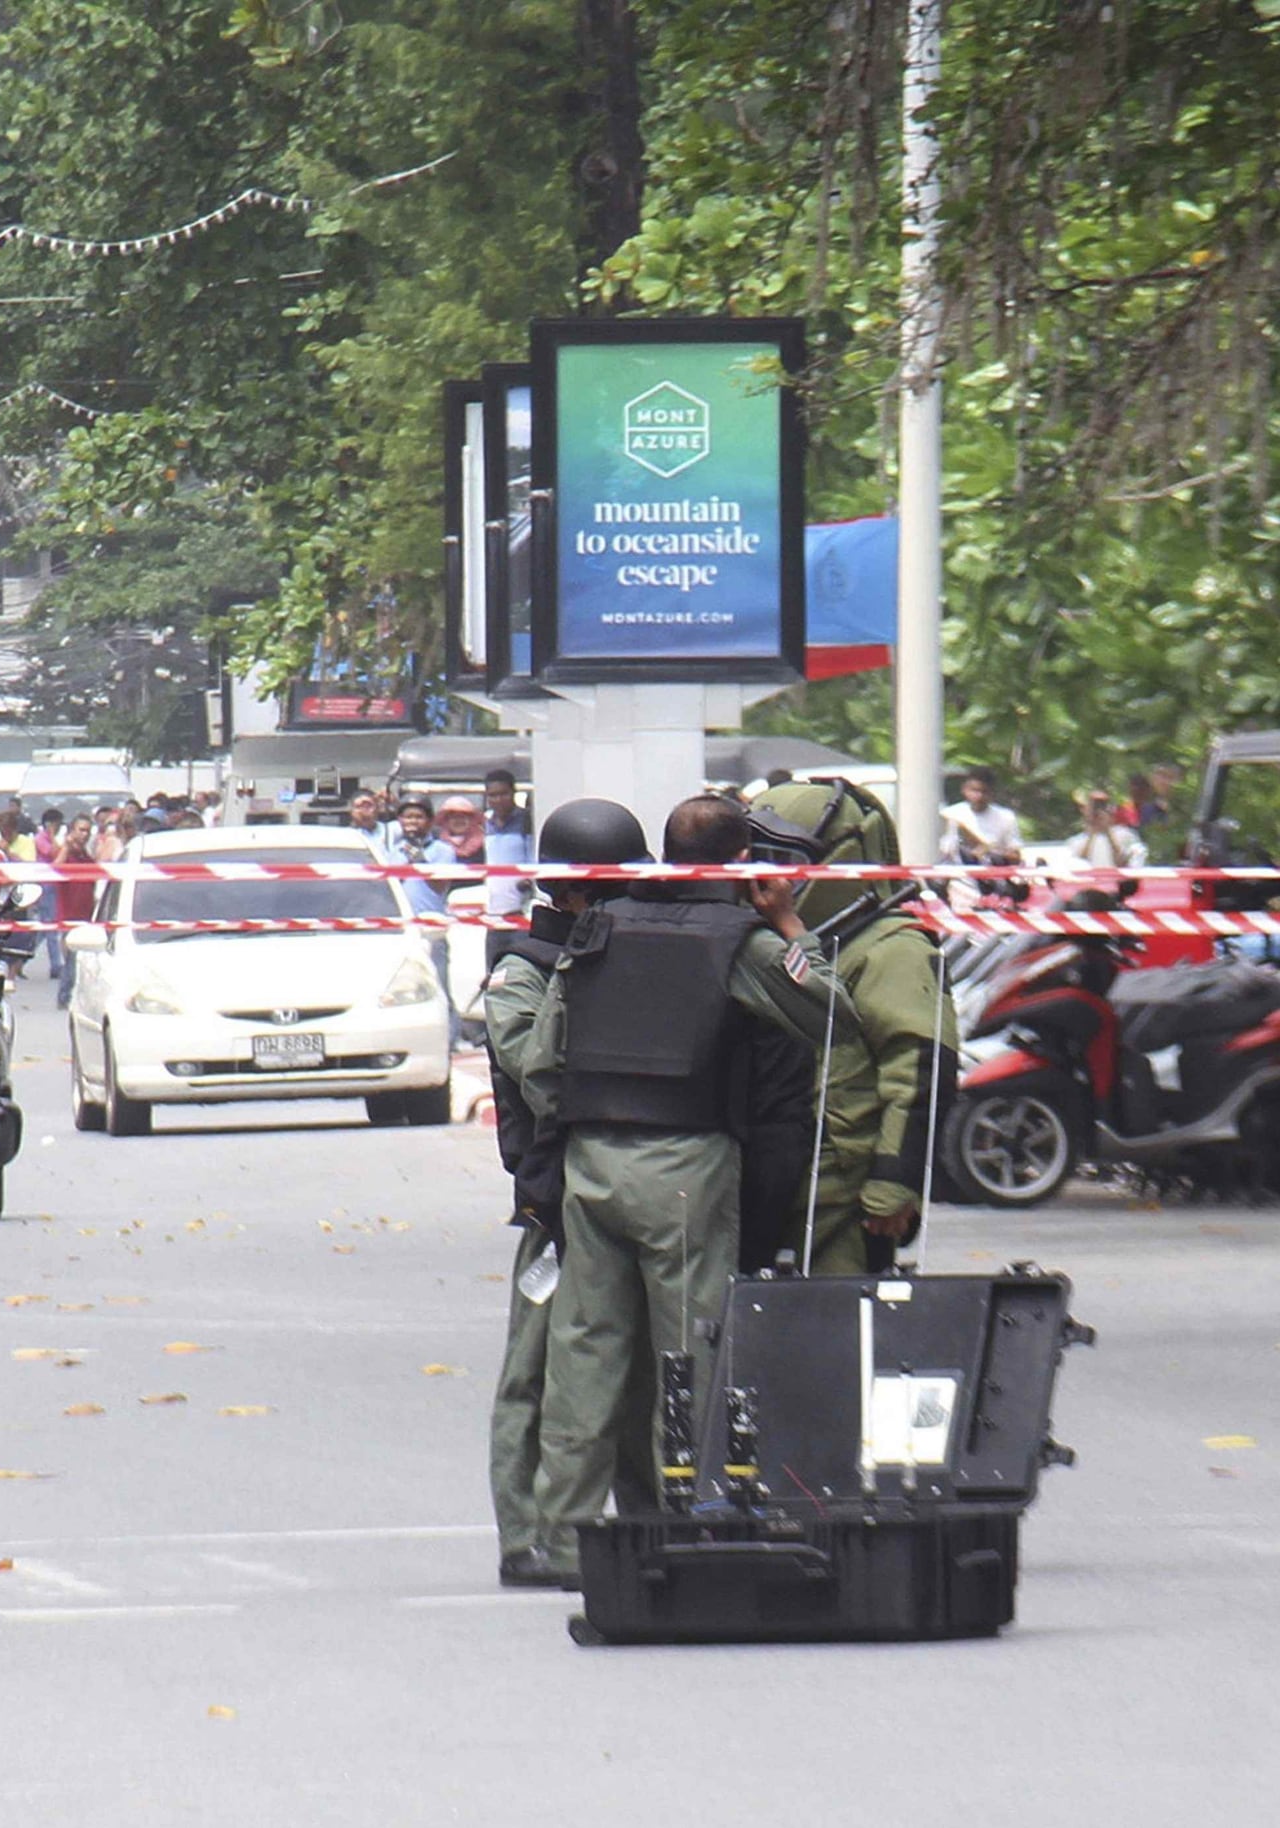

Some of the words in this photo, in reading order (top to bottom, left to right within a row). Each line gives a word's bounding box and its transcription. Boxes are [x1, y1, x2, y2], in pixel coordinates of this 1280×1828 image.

[636, 408, 699, 425] MONT
[631, 434, 702, 449] AZURE
[593, 496, 741, 523] mountain
[575, 529, 606, 554] to
[612, 526, 760, 554] oceanside
[617, 562, 718, 591] escape
[600, 612, 734, 624] MONTAZURE.COM
